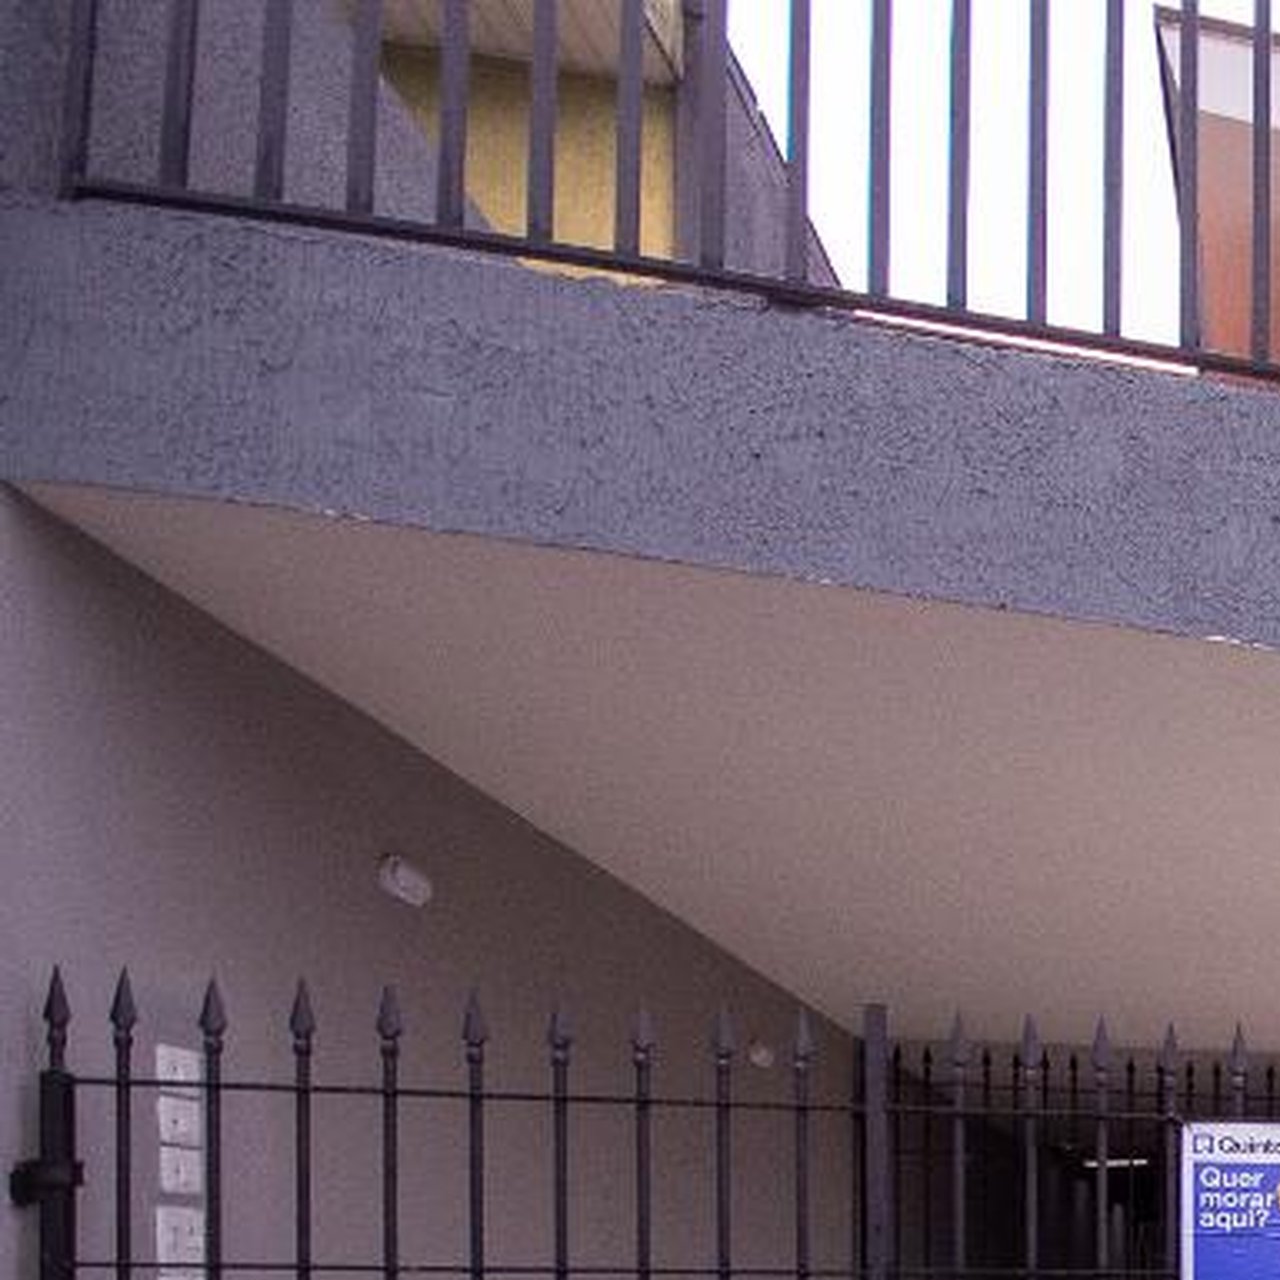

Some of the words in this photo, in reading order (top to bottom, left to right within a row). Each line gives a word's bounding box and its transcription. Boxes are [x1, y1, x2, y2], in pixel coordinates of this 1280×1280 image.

[1200, 1167, 1264, 1188] Quer
[1200, 1191, 1274, 1208] morar
[1200, 1209, 1268, 1232] aqui?
